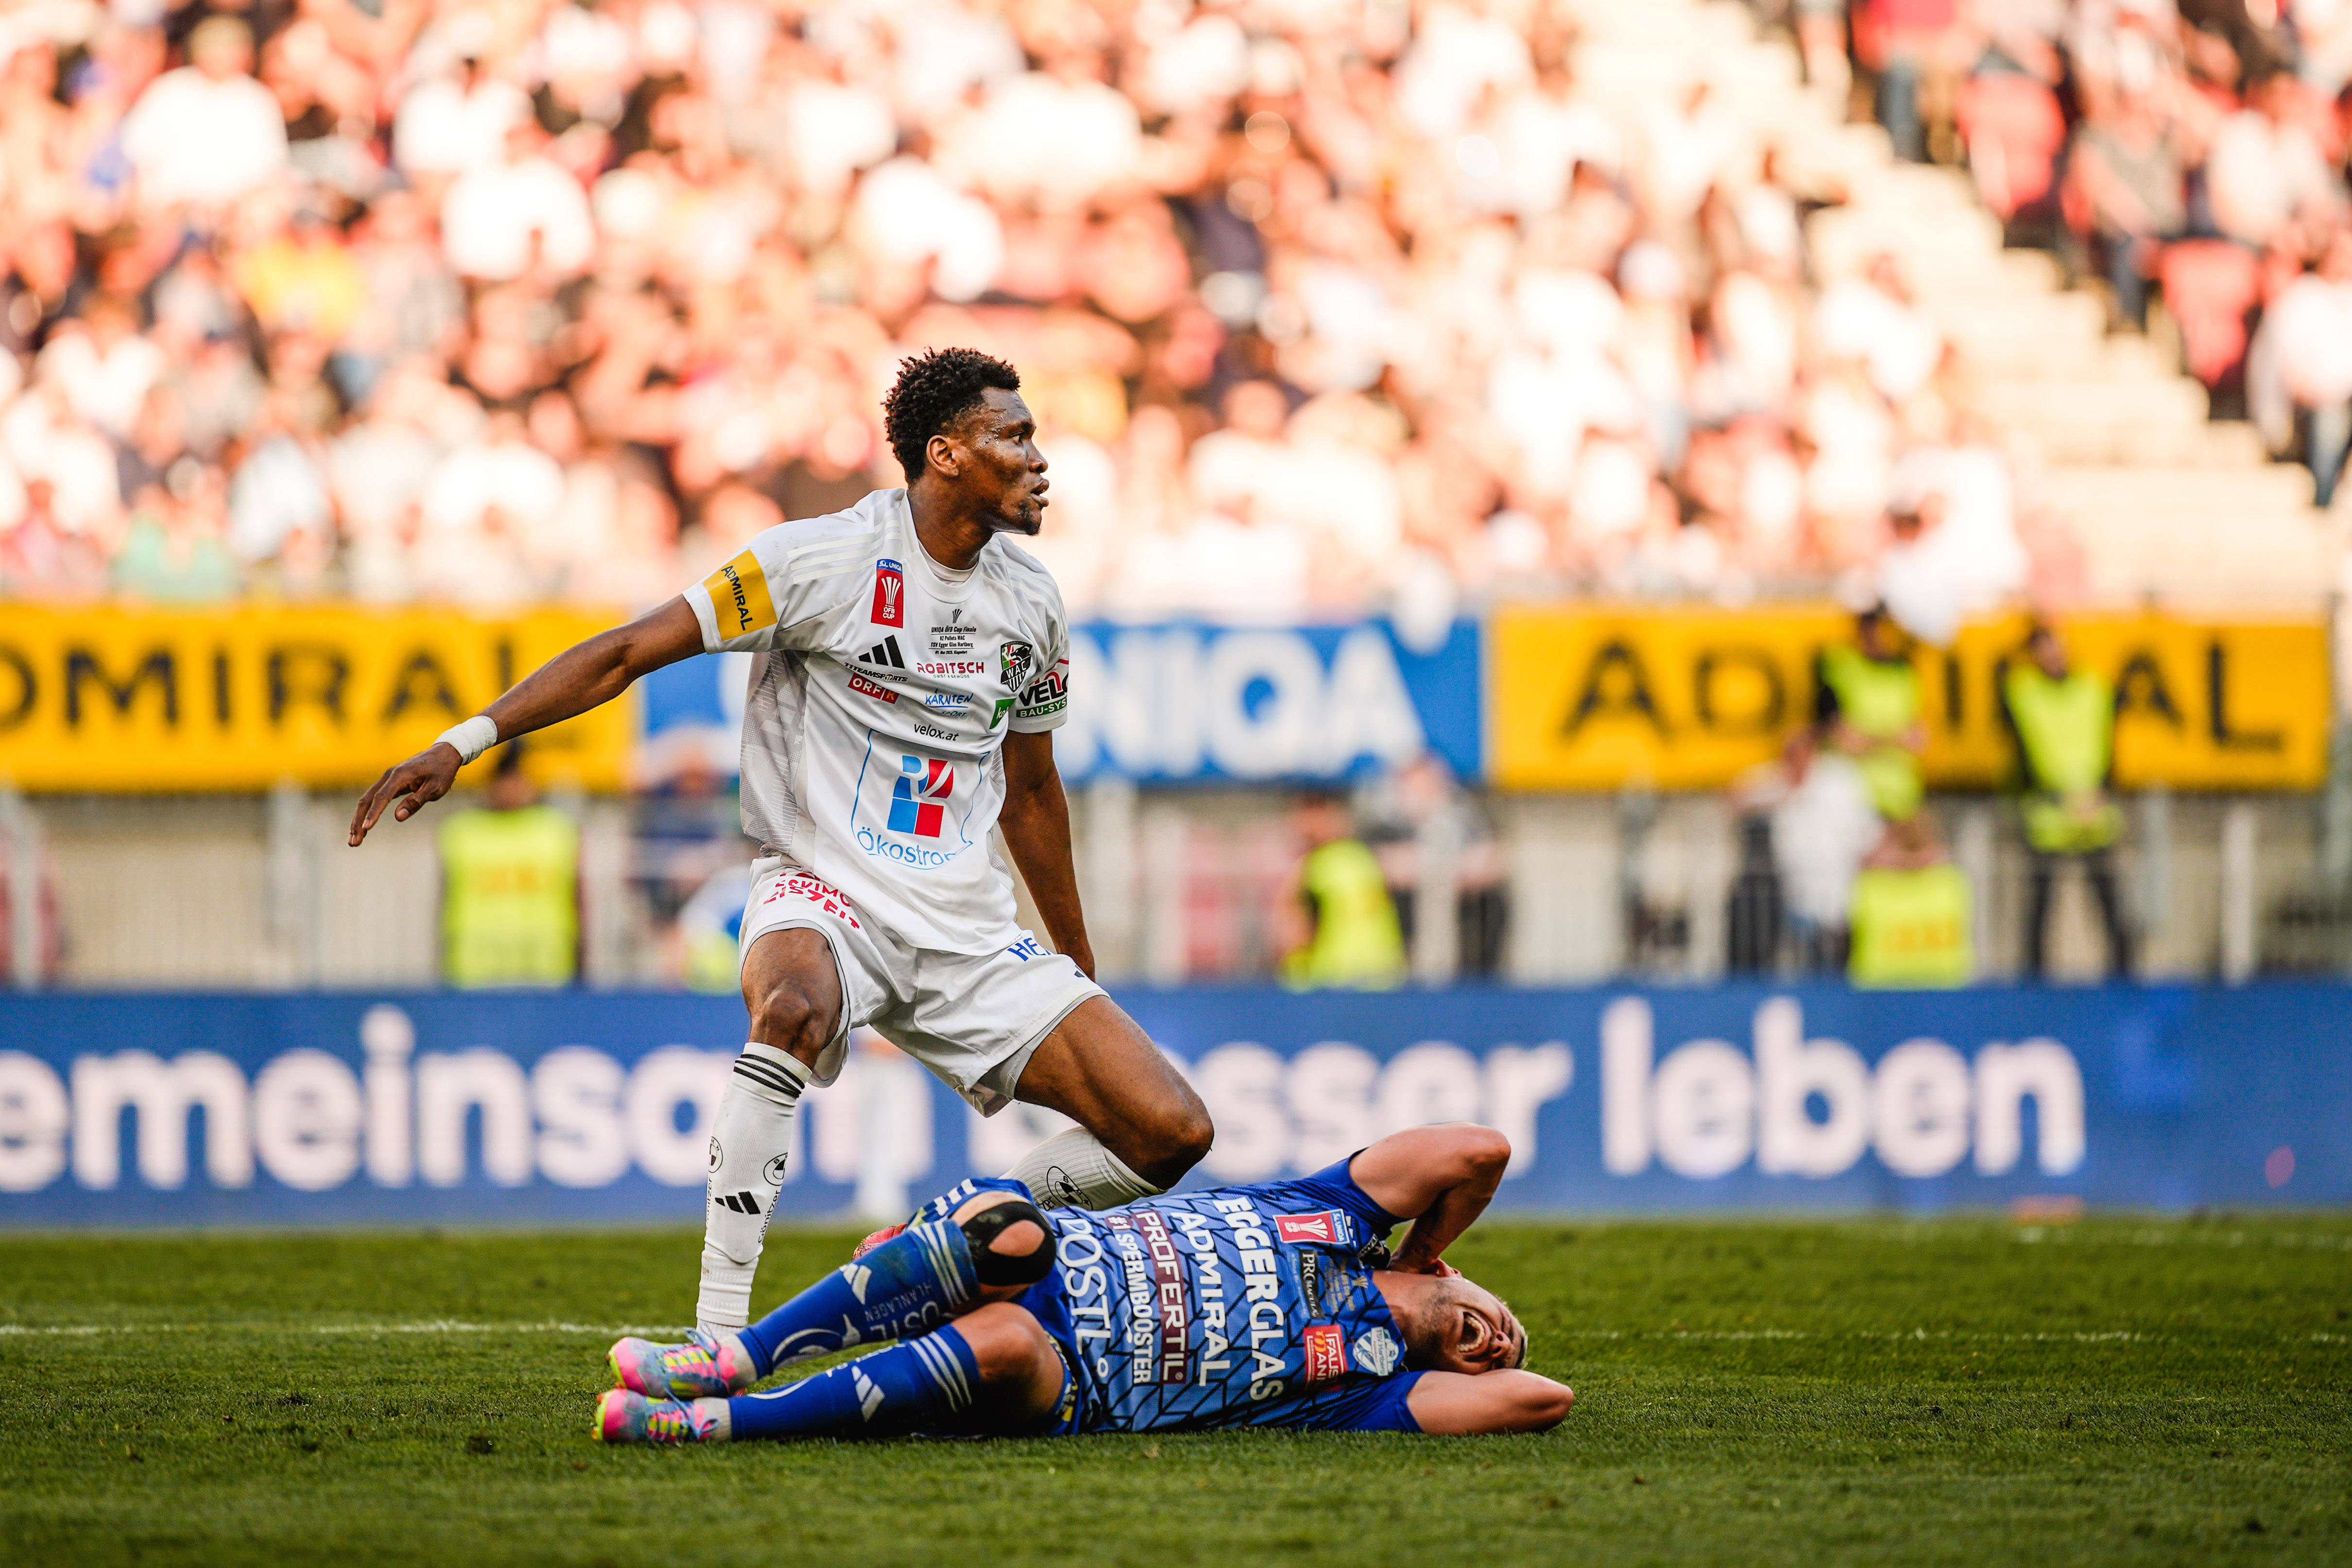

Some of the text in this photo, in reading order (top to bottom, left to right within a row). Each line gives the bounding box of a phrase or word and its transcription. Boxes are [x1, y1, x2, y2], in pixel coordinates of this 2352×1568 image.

[721, 566, 753, 631] ADMIRAL
[853, 678, 883, 694] ORF
[917, 662, 984, 674] ROBITSCH
[1006, 660, 1027, 678] WAC
[914, 724, 959, 741] velox.at
[1600, 996, 2086, 1178] leben
[1115, 1233, 1154, 1384] SPERMBOOSTER
[1170, 1212, 1231, 1387] ADMIRAL
